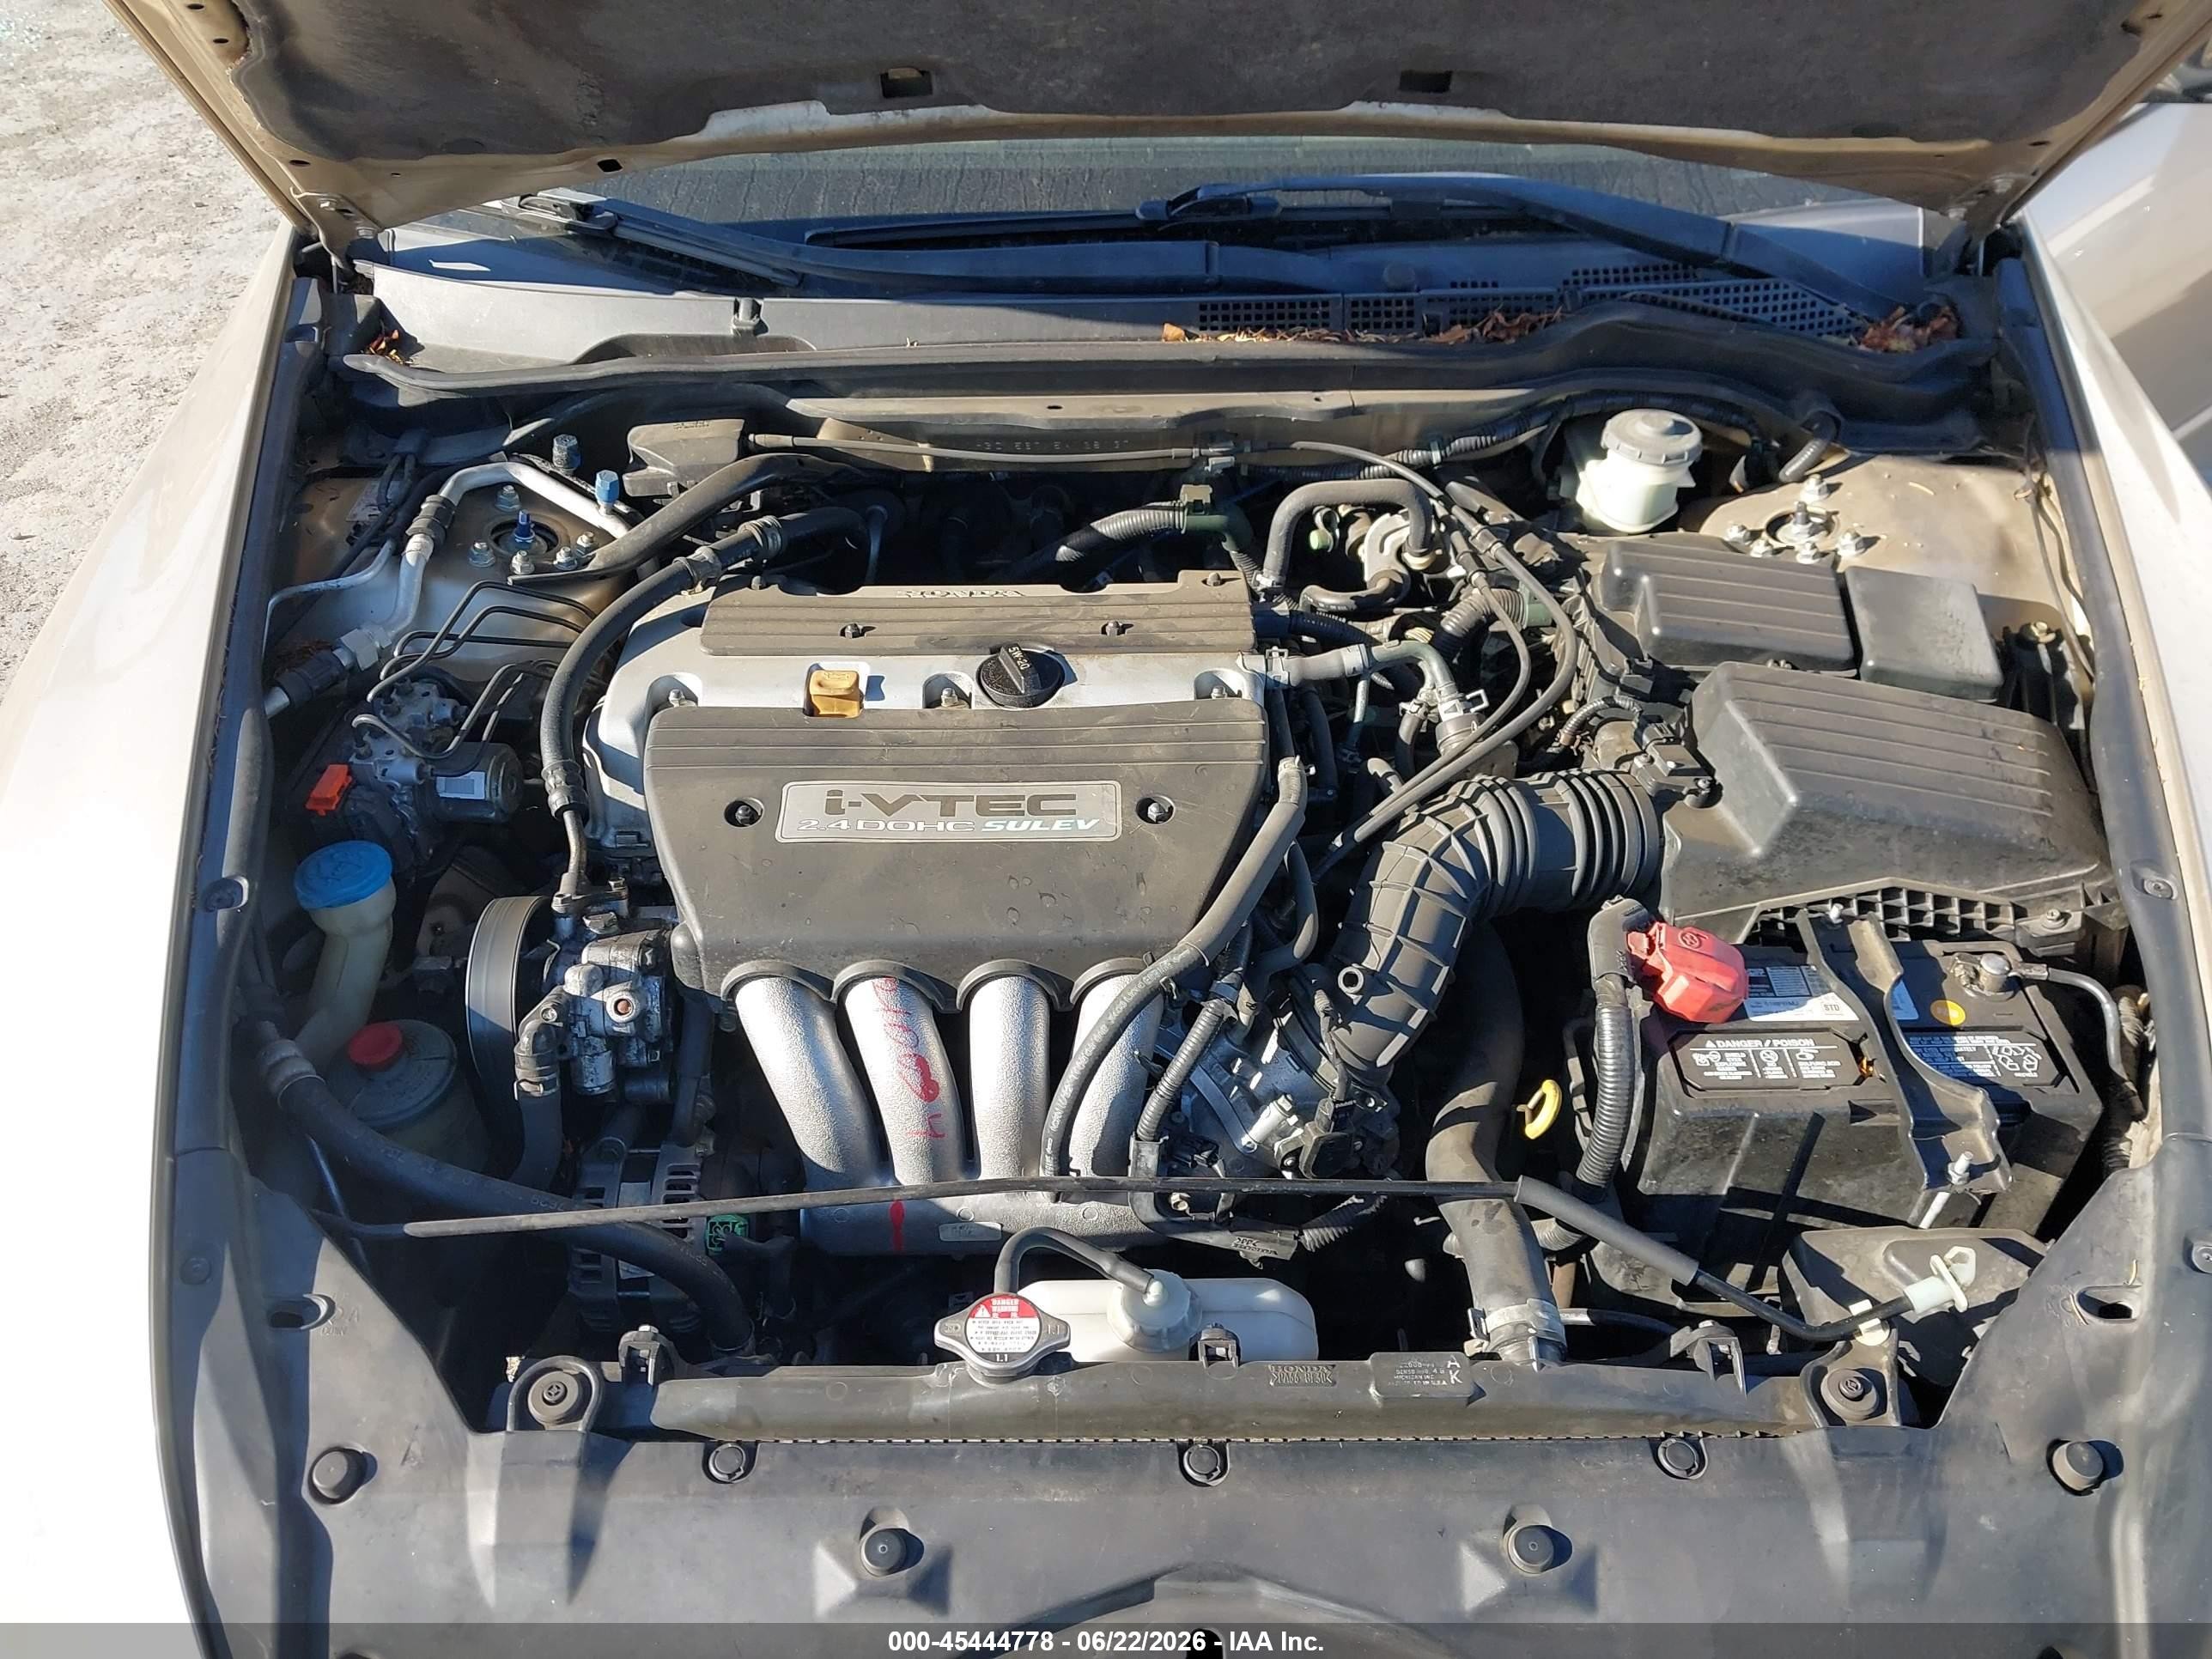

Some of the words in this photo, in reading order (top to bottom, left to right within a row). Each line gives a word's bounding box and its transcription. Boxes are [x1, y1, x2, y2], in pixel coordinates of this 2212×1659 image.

[1008, 646, 1031, 671] 5W-20
[824, 789, 1077, 817] i-VTEC
[796, 818, 851, 832] 2.4
[856, 819, 975, 832] DOHC
[981, 818, 1100, 832] SULEV
[1717, 1040, 1761, 1048] DANGER
[1771, 1038, 1815, 1047] POISON
[995, 1353, 1008, 1362] 1.1
[1449, 1370, 1463, 1384] K
